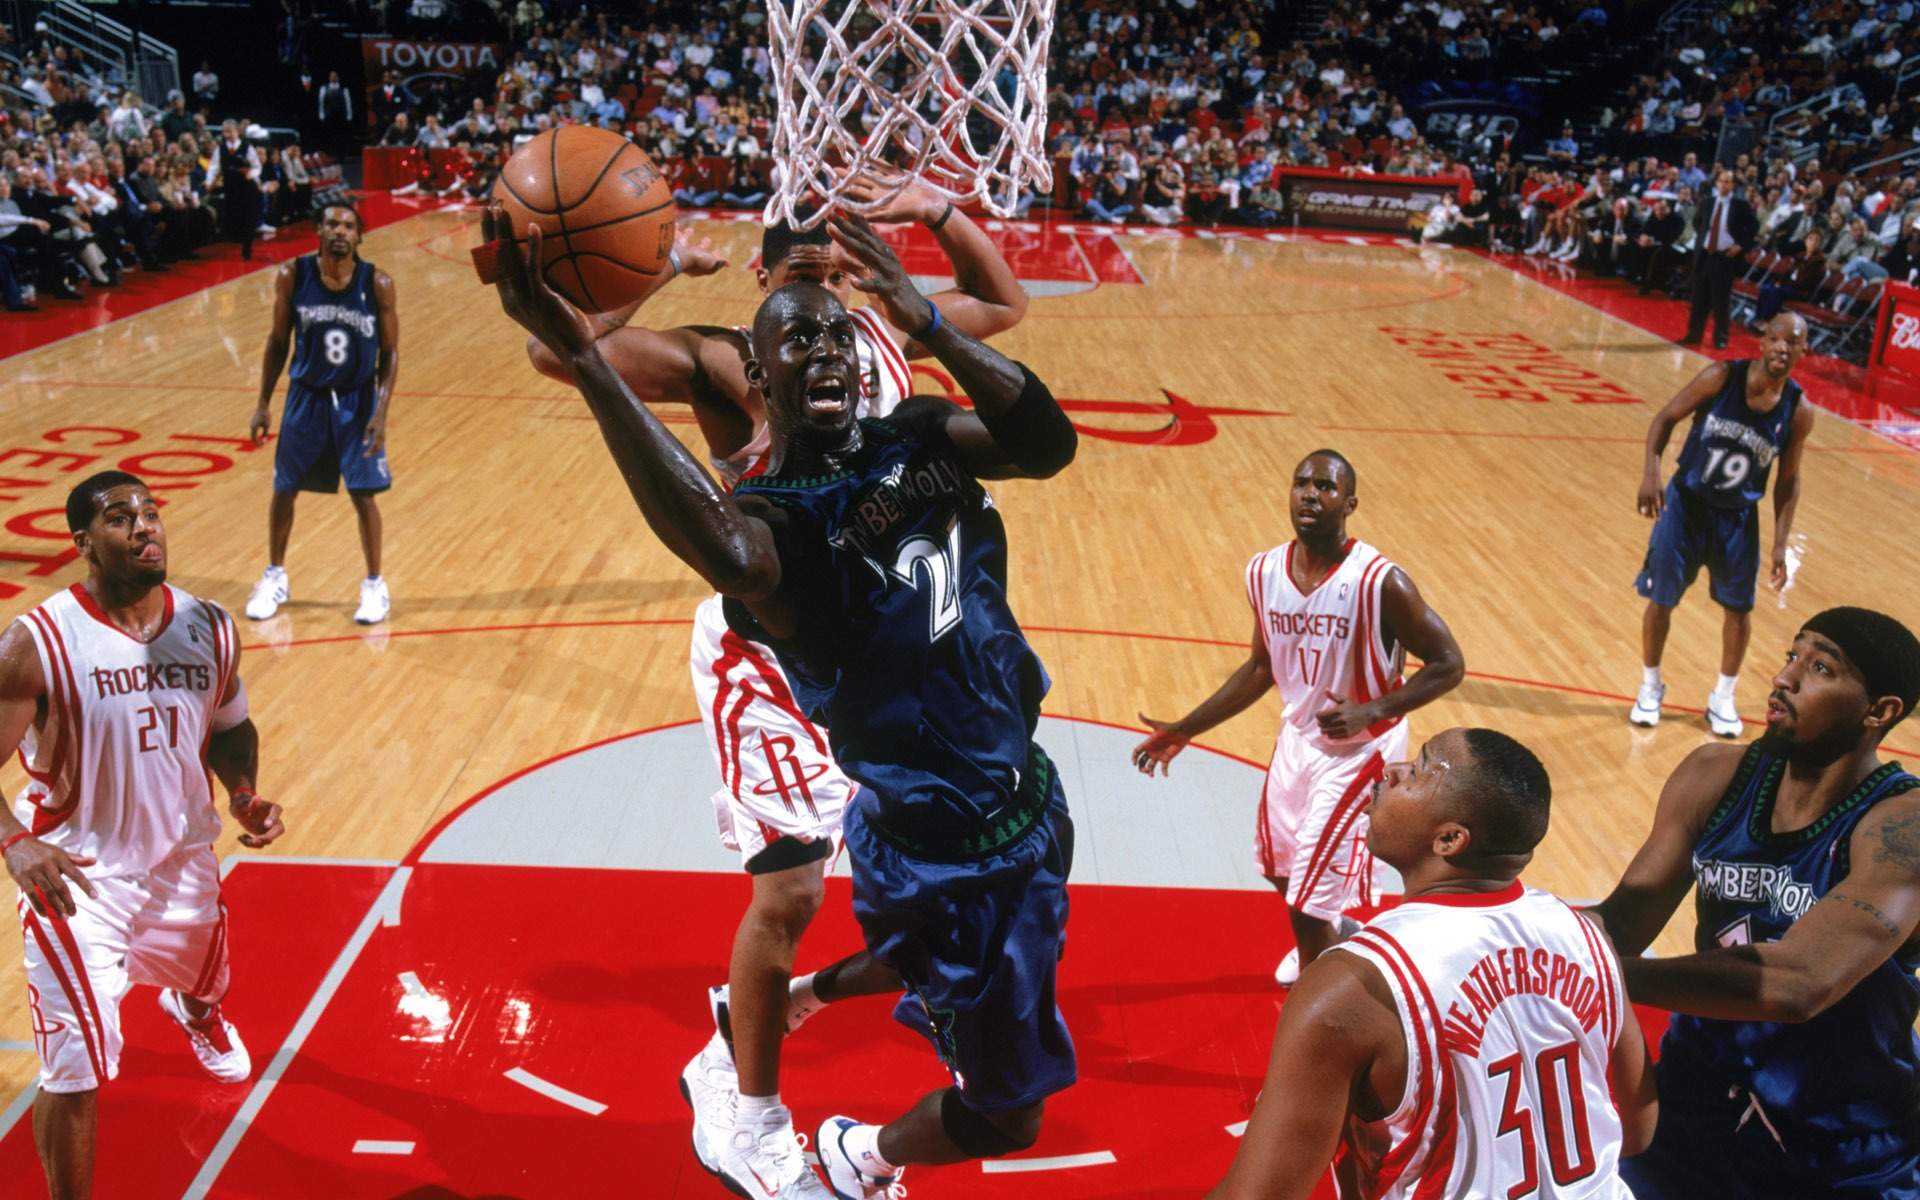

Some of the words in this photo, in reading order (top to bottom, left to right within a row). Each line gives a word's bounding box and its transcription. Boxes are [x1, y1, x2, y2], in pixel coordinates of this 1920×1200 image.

[375, 42, 497, 68] TOYOTA
[325, 329, 348, 364] 8
[1377, 326, 1550, 403] CENTER
[1456, 331, 1647, 404] TOYOTA
[1701, 447, 1751, 490] 19
[886, 511, 963, 644] 21
[1268, 608, 1350, 640] ROCKETS
[89, 663, 210, 700] ROCKETS
[1298, 647, 1322, 687] 17
[137, 705, 178, 753] 21
[1443, 946, 1603, 1060] WEATHERSPOON
[1487, 1040, 1597, 1200] 30
